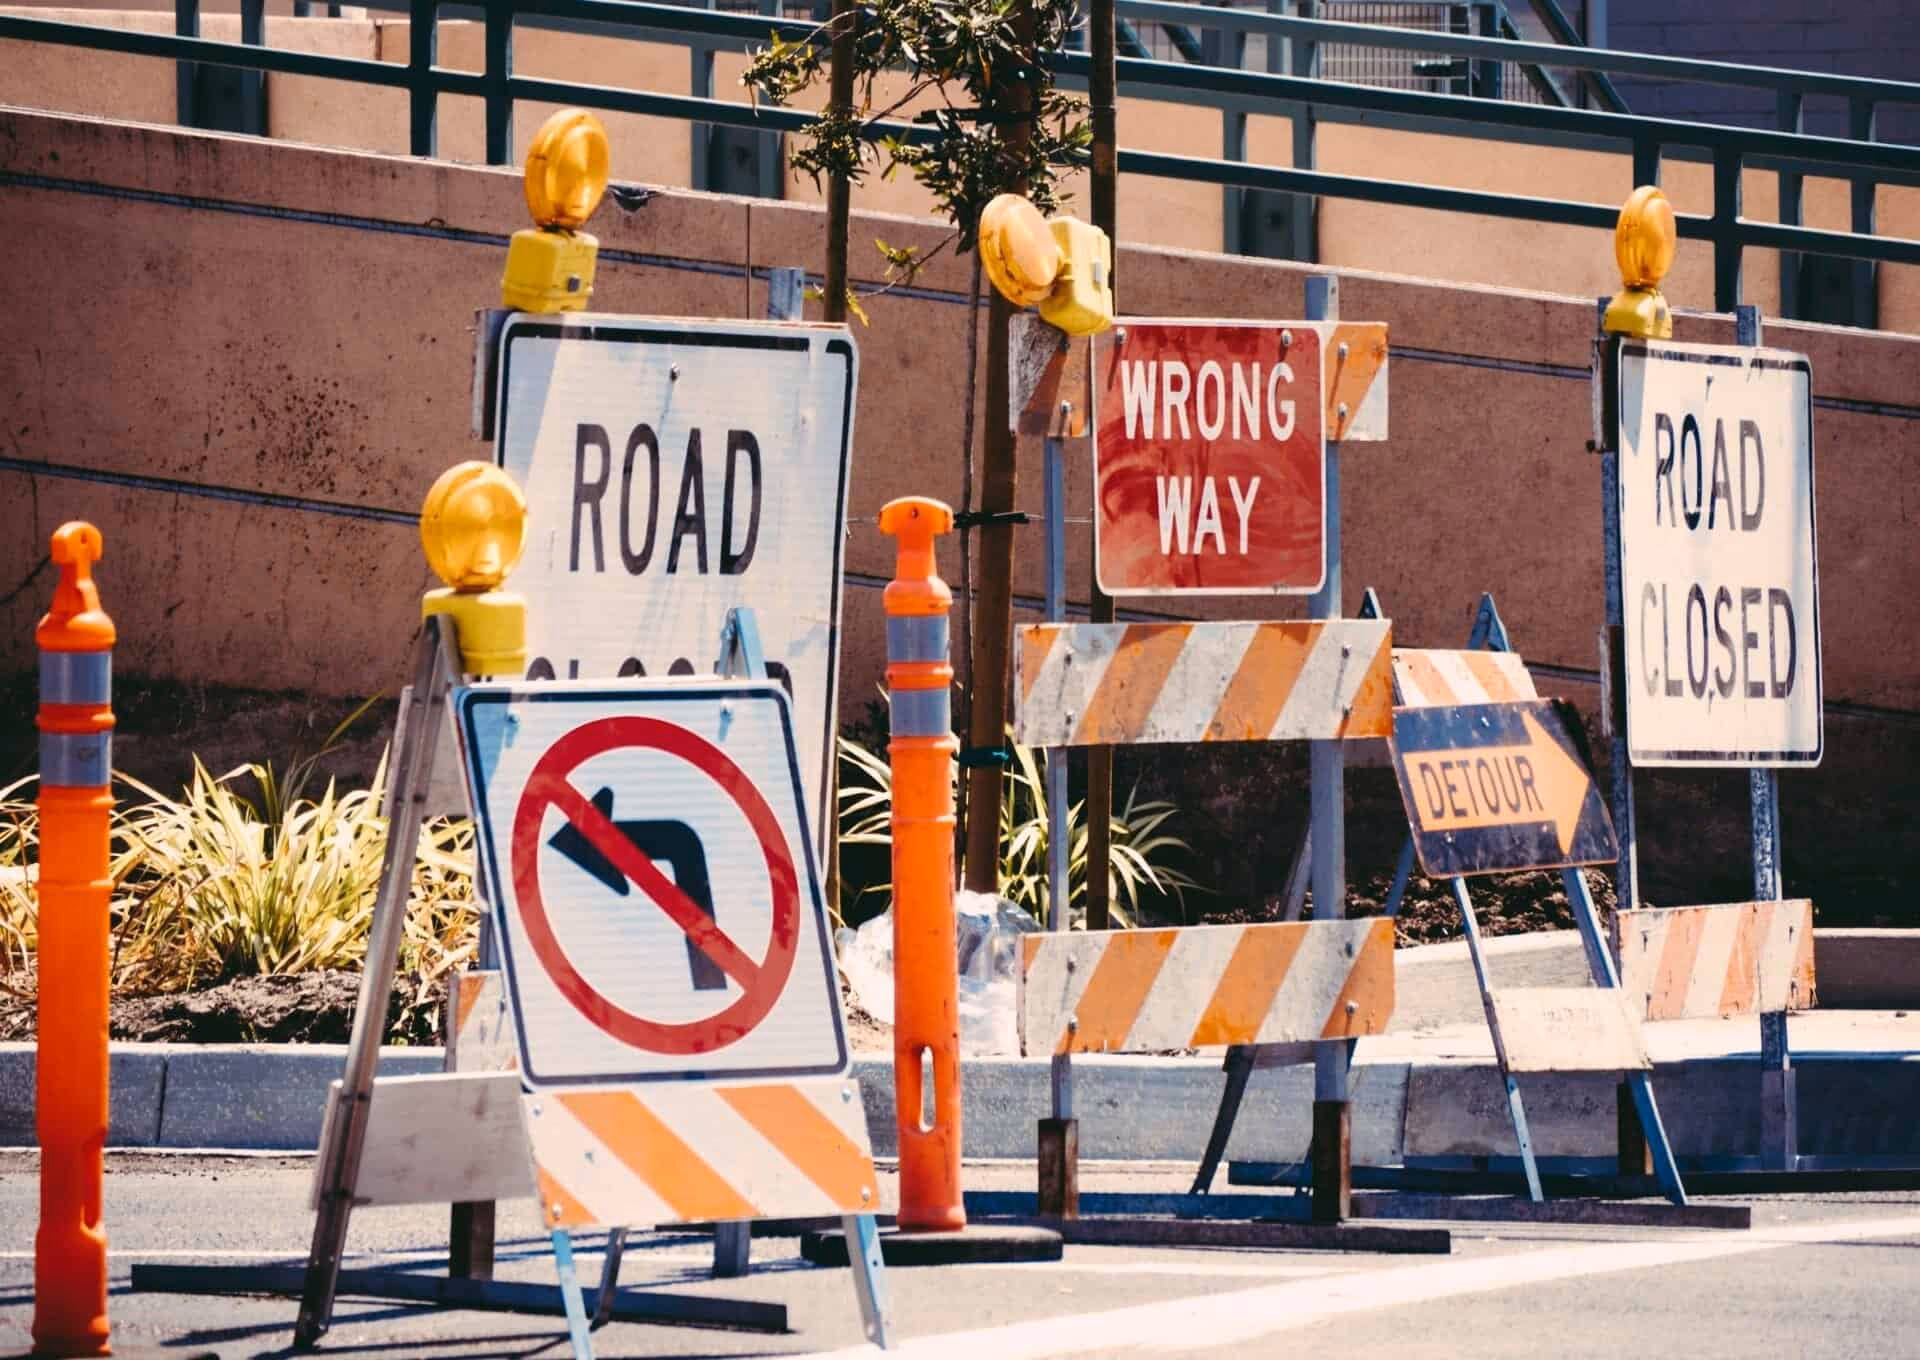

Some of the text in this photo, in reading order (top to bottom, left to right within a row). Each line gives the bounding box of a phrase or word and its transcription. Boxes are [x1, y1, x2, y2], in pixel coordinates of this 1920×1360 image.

[1120, 359, 1296, 441] WRONG
[569, 423, 763, 576] ROAD
[1155, 475, 1262, 555] WAY
[1655, 412, 1766, 531] ROAD
[1640, 580, 1797, 699] CLOSED
[1418, 755, 1544, 819] DETOUR
